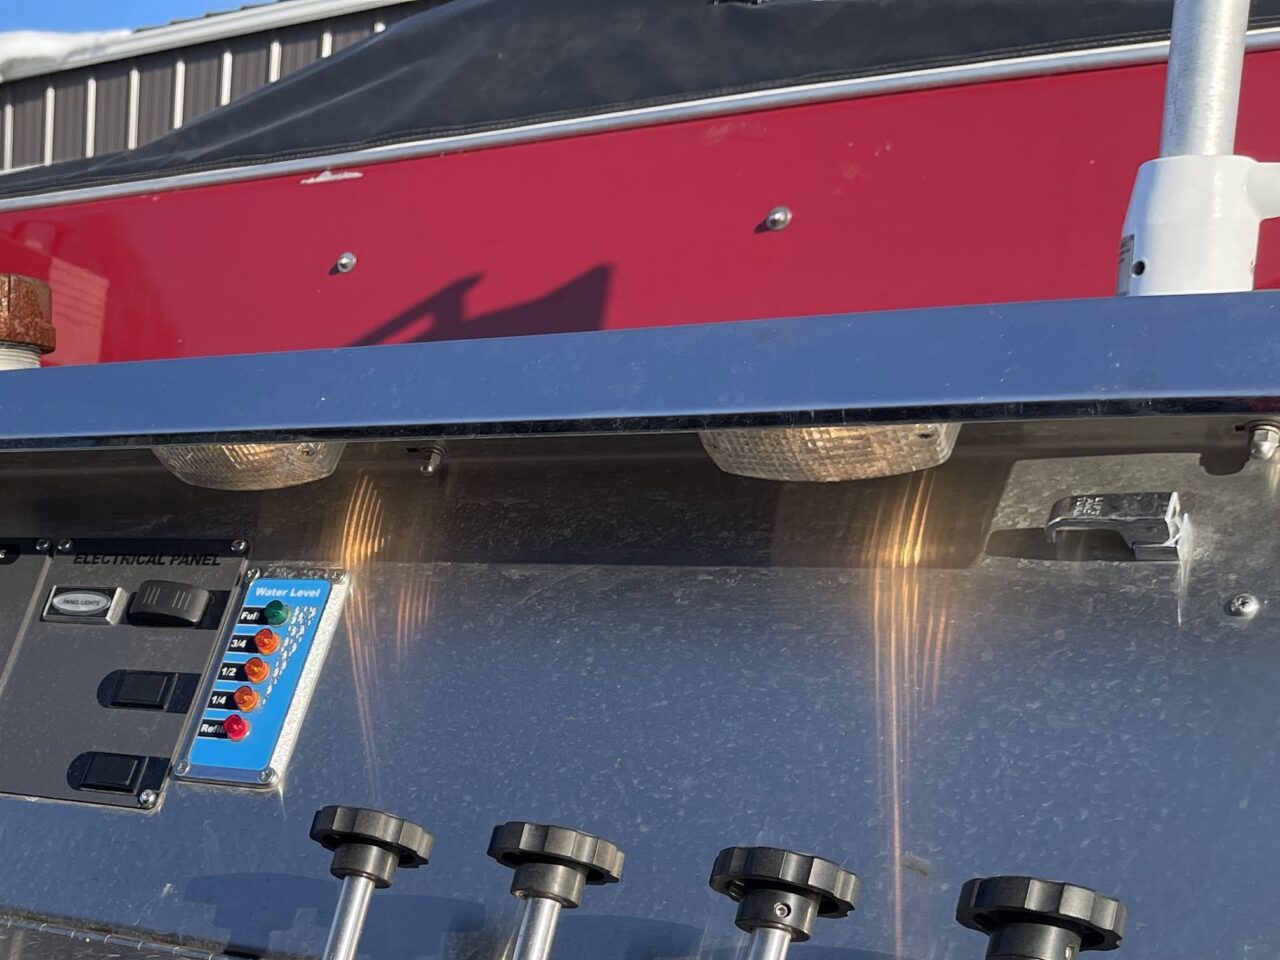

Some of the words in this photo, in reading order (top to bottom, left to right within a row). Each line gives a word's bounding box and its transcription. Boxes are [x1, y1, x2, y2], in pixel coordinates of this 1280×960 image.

[73, 553, 166, 566] ELECTRICAL
[169, 554, 221, 567] PANEL
[255, 587, 288, 597] Water
[290, 588, 321, 598] Level
[241, 612, 259, 620] Full
[231, 640, 246, 648] 3/4
[221, 667, 237, 676] 1/2
[211, 696, 227, 704] 1/4
